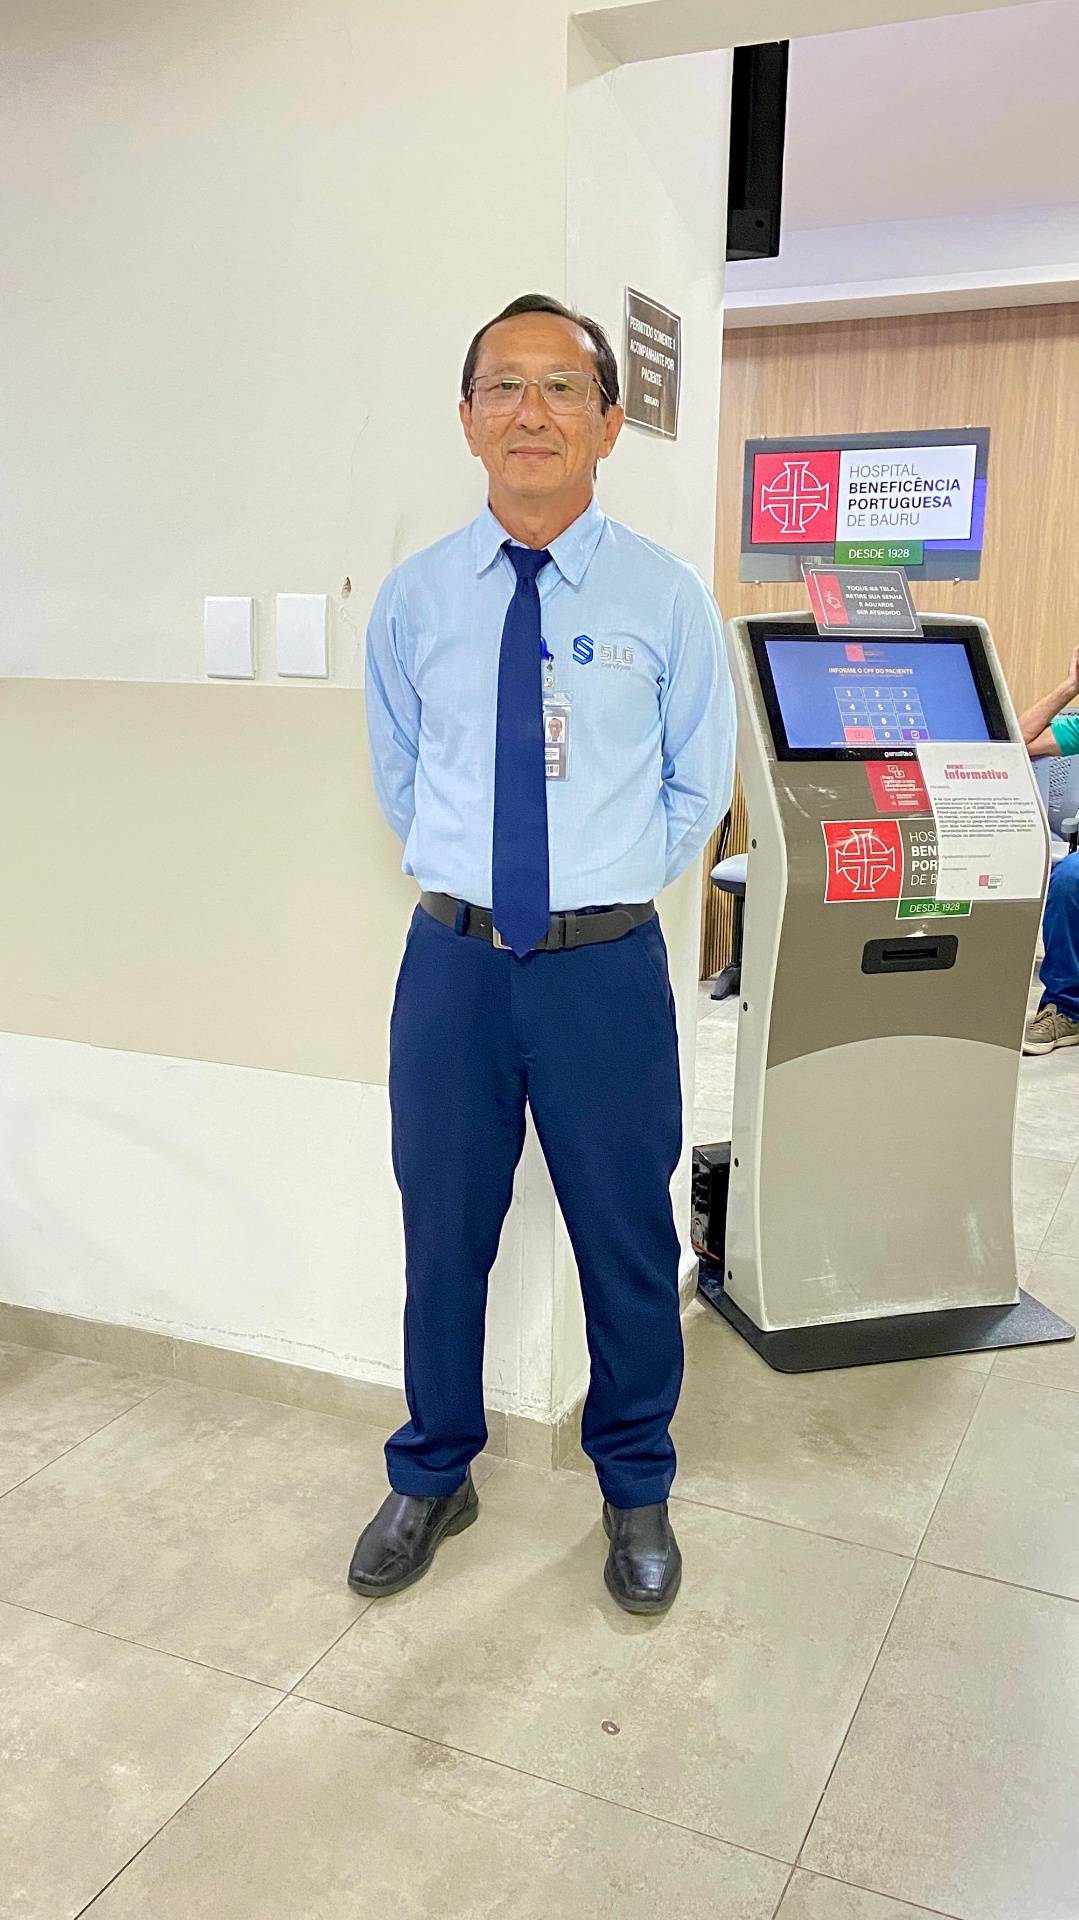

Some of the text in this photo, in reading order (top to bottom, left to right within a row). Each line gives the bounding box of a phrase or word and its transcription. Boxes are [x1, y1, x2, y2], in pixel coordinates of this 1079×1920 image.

[630, 315, 653, 339] PERMITIDO
[654, 328, 672, 350] SOMENTE
[630, 338, 674, 371] ACOMPANHANTE POR
[642, 366, 662, 386] PACIENTE
[850, 464, 918, 478] HOSPITAL
[849, 477, 960, 494] BENEFICÊNCIA
[848, 496, 952, 510] PORTUGUESA
[847, 513, 920, 526] DE BAURU
[848, 548, 910, 559] DESDE 1928
[600, 644, 634, 664] SLG
[944, 770, 1008, 780] Informativo
[909, 831, 936, 842] HOS
[912, 846, 937, 856] BEN
[912, 860, 938, 872] POR
[911, 874, 938, 886] DE B
[910, 902, 960, 912] DESDE 1928
